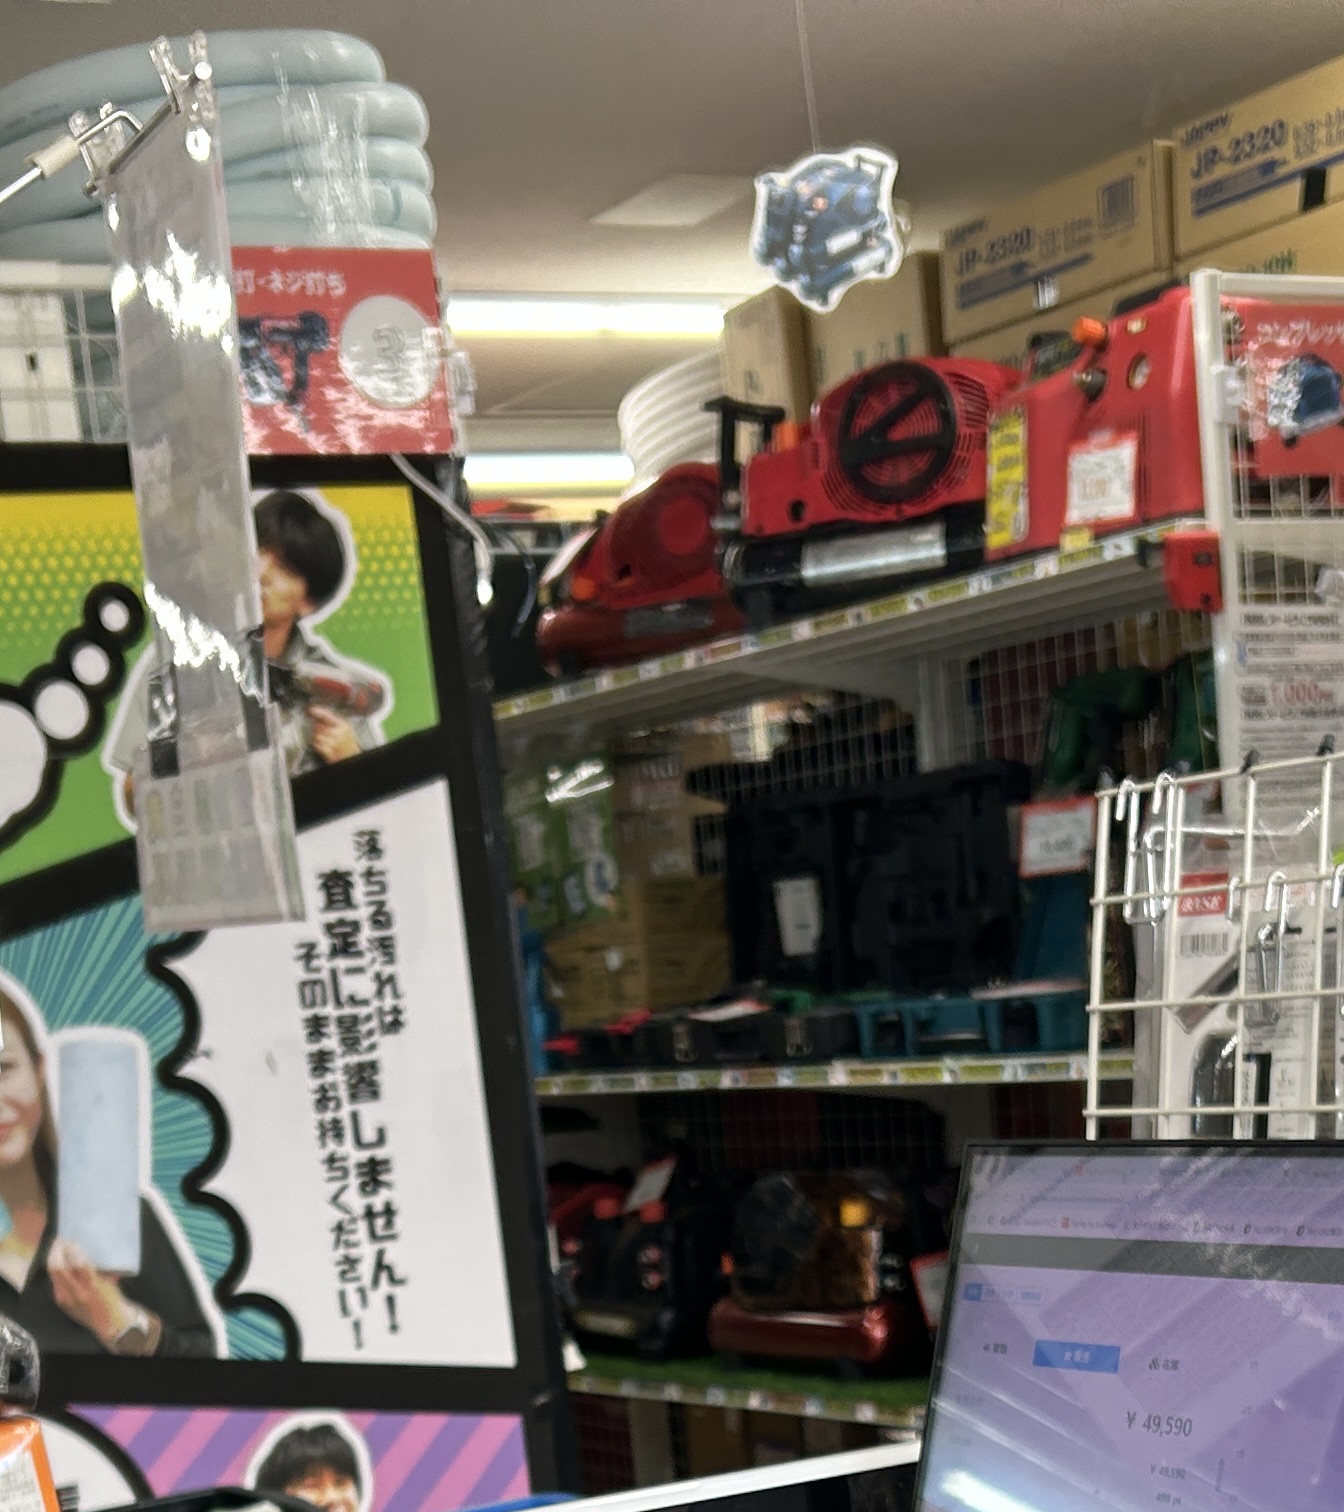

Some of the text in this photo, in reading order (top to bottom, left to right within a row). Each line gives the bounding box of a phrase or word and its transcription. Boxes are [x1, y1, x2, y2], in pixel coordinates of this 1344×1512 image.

[1190, 119, 1288, 180] JP-2320
[353, 828, 406, 1039] 落ちる汚れは
[293, 940, 366, 1351] そのままお持ちください！
[315, 868, 408, 1335] 査定に影響しません！
[1141, 1411, 1194, 1438] 49,590
